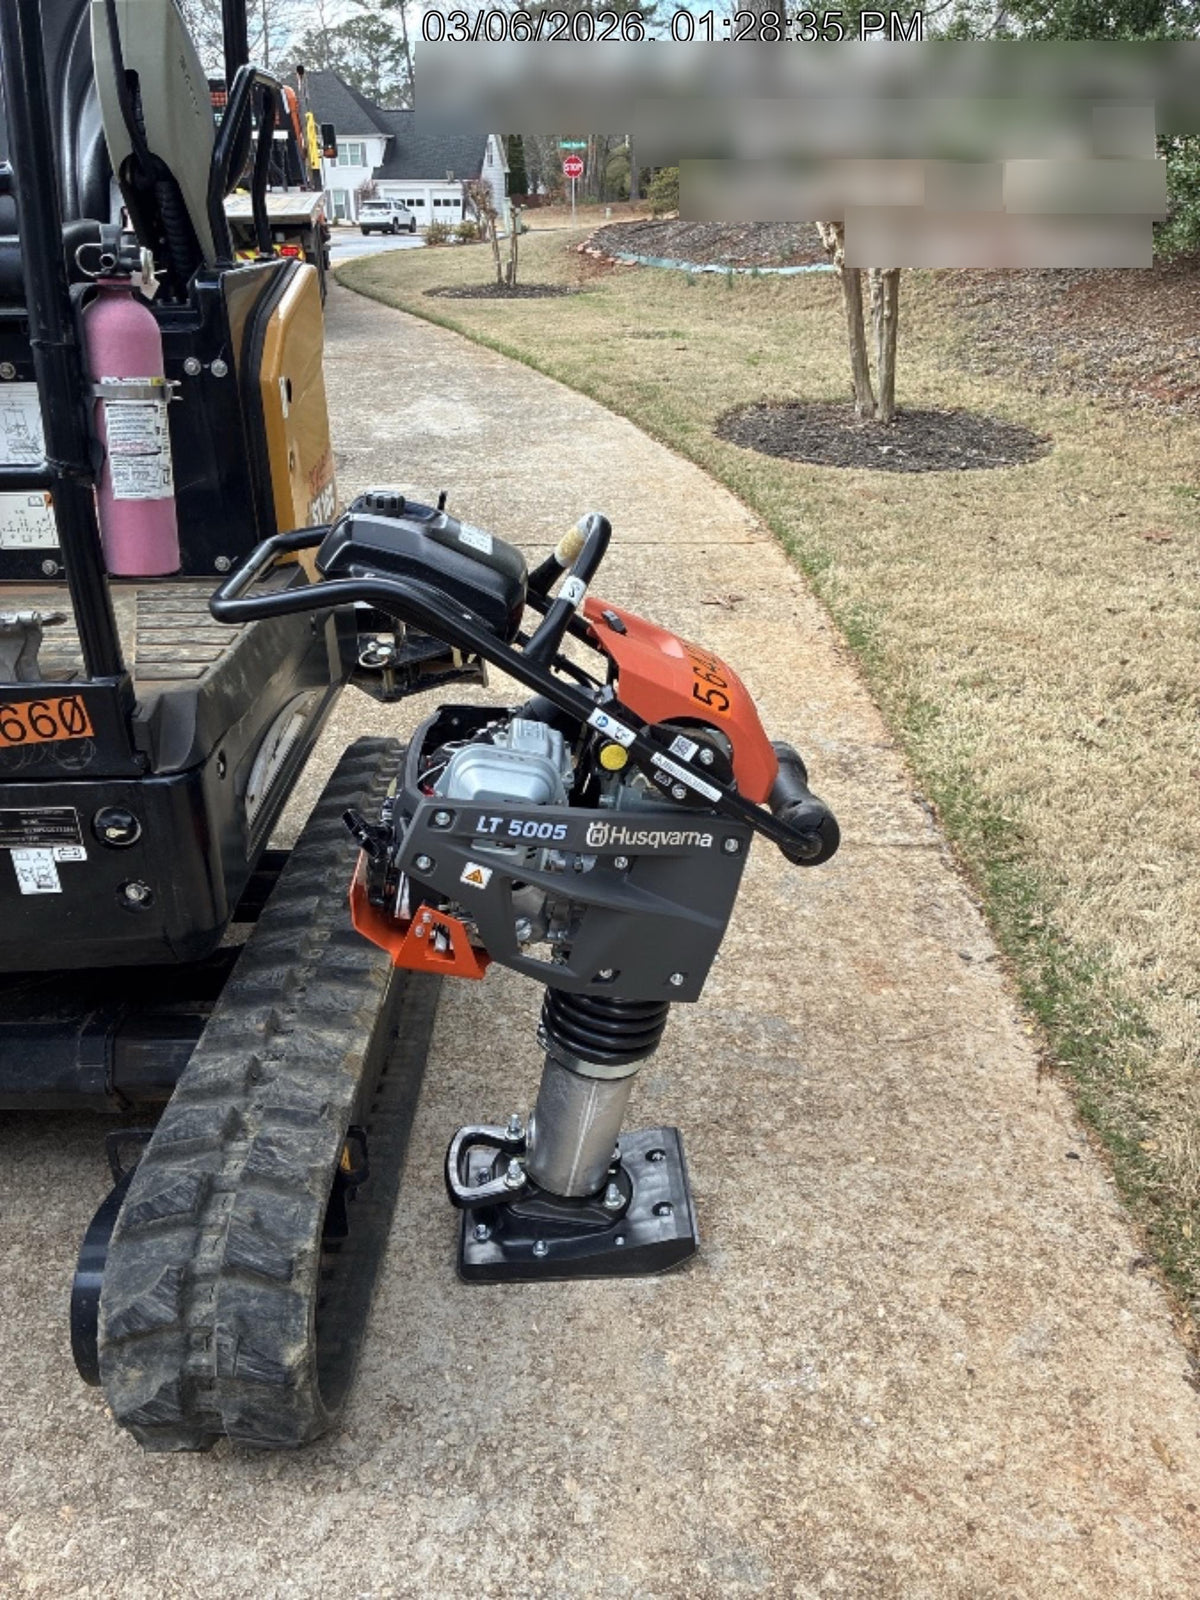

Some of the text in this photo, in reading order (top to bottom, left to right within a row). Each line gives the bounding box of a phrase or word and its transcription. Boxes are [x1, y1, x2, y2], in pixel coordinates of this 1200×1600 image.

[564, 162, 582, 172] STOP
[476, 815, 568, 841] LT 5005
[610, 826, 714, 849] Husqvarna
